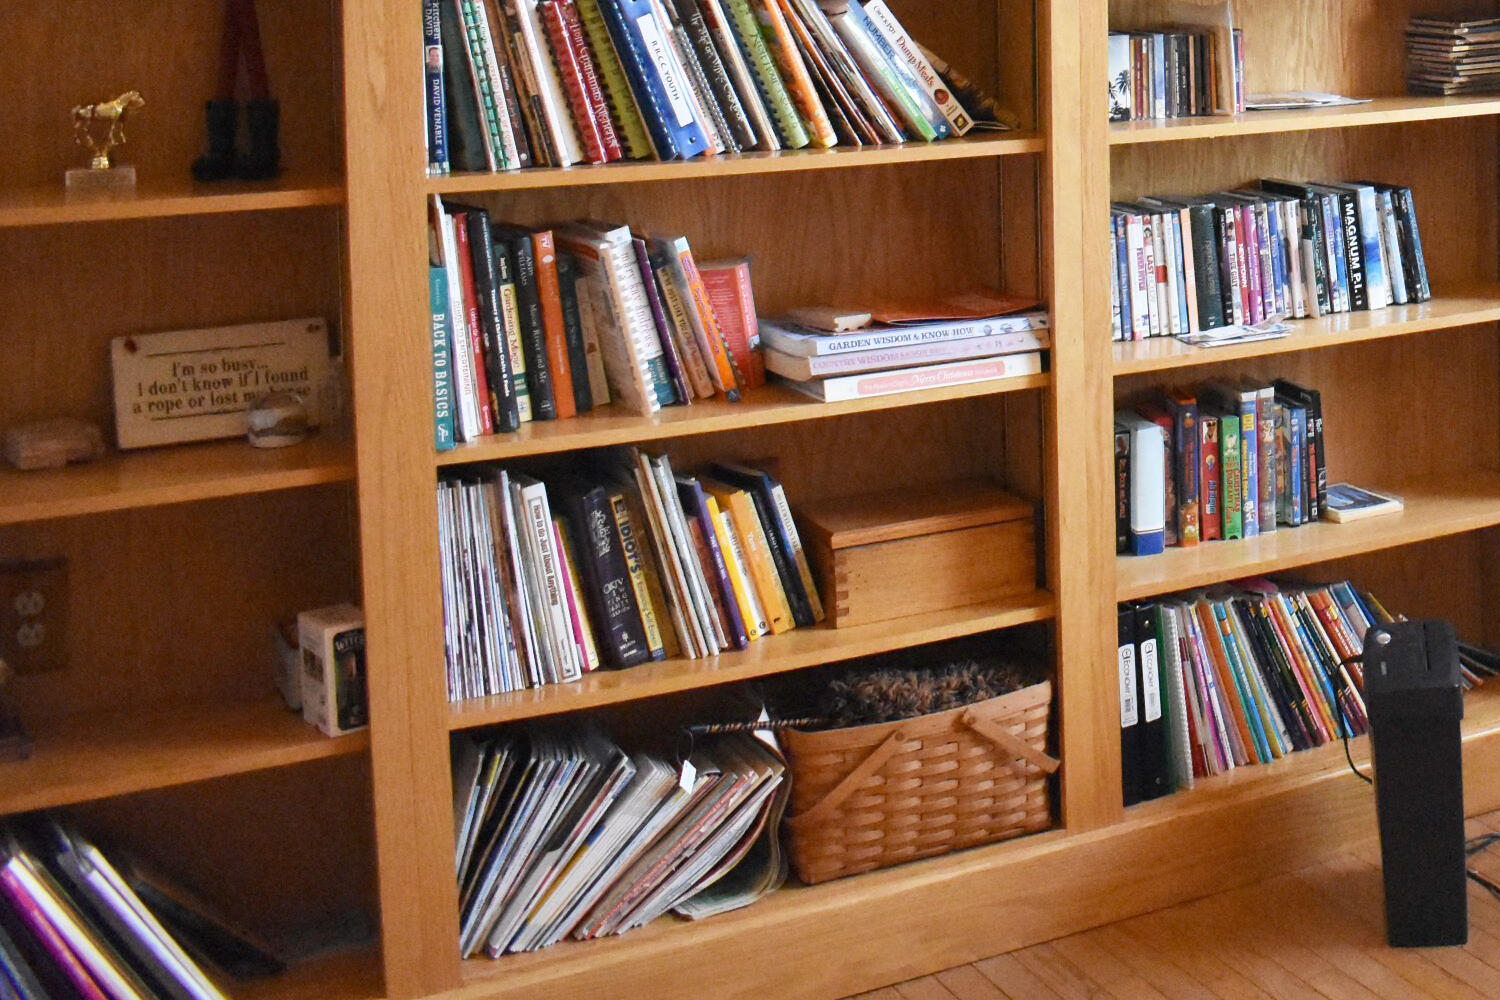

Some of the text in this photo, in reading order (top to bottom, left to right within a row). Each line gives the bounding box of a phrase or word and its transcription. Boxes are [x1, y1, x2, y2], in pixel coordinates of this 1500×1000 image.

[860, 14, 896, 60] NUMBER
[892, 34, 920, 65] Dump
[913, 59, 937, 88] Meals
[662, 70, 682, 100] YOUTH
[432, 79, 442, 144] DAVID VENABLE
[1135, 247, 1145, 269] FEVER
[1344, 202, 1363, 293] MAGNUM P.I.
[1239, 264, 1247, 287] TOWN
[500, 287, 517, 337] Gardening
[617, 251, 657, 347] mary kay andrews
[431, 312, 446, 347] BACK
[528, 303, 547, 383] Moon River and Me
[828, 337, 871, 351] GARDEN
[873, 333, 911, 346] WISDOM
[172, 361, 195, 378] I'm
[200, 364, 217, 375] so
[433, 350, 447, 366] TO
[856, 351, 900, 365] WISDOM
[137, 382, 143, 397] I
[148, 378, 187, 396] don't
[192, 377, 233, 392] know
[239, 371, 253, 386] if
[264, 368, 309, 384] found
[433, 371, 449, 418] BASICS
[132, 402, 142, 414] a
[147, 398, 184, 414] rope
[188, 397, 203, 408] or
[210, 392, 237, 407] lost
[532, 503, 560, 606] How to do Just About Anything
[618, 520, 642, 574] IDIOT'S
[1121, 659, 1132, 694] ECONOMY
[1145, 653, 1155, 687] ECONOMY
